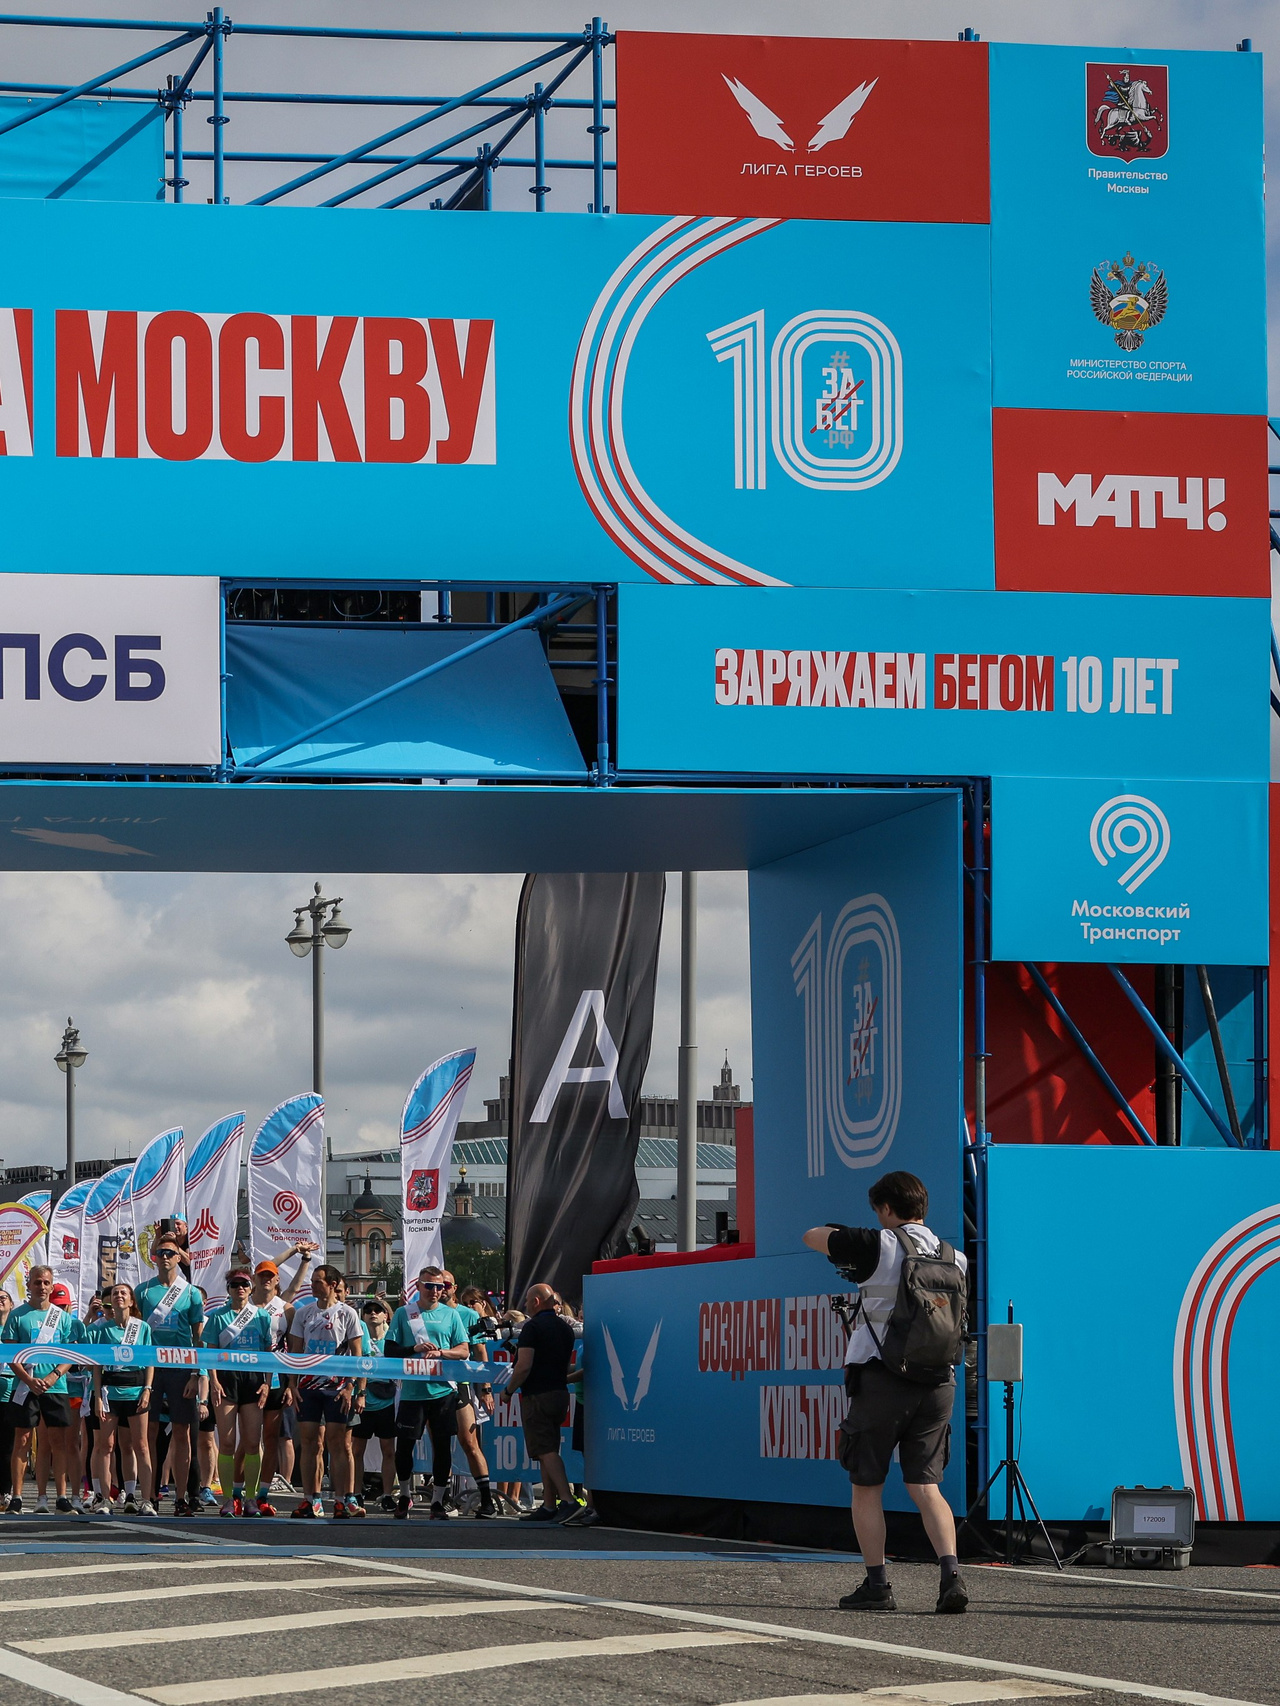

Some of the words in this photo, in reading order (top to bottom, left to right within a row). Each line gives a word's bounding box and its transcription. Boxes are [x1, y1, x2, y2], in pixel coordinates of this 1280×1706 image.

[741, 162, 788, 178] ЛИГА
[794, 164, 863, 179] ГЕРОЕВ
[1088, 168, 1168, 180] Правительство
[1107, 183, 1149, 194] Москвы
[1070, 359, 1147, 370] МИНИСТЕРСТВО
[1149, 361, 1187, 370] СПОРТА
[1067, 369, 1133, 380] РОССИЙСКОЙ
[1135, 372, 1193, 382] ФЕДЕРАЦИИ
[56, 309, 497, 465] МОСКВУ
[1038, 472, 1227, 532] МАТЧ!
[715, 648, 926, 710] ЗАРЯЖАЕМ
[934, 655, 1055, 712] БЕГОМ
[1062, 658, 1096, 714] 10
[1108, 657, 1179, 715] ЛЕТ
[1071, 899, 1190, 919] Московский
[1080, 922, 1181, 945] Транспорт
[267, 1226, 311, 1235] Московский
[189, 1245, 225, 1260] ОСКОВСКИЙ
[698, 1298, 781, 1381] СОЗДАЕМ
[784, 1292, 859, 1370] БЕГОВ
[157, 1347, 198, 1364] СТАРТ
[230, 1353, 258, 1364] ПСБ
[403, 1358, 442, 1375] СТАРТ
[607, 1427, 626, 1441] ЛИГА
[628, 1428, 655, 1443] ГЕРОЕВ
[494, 1435, 517, 1470] 10
